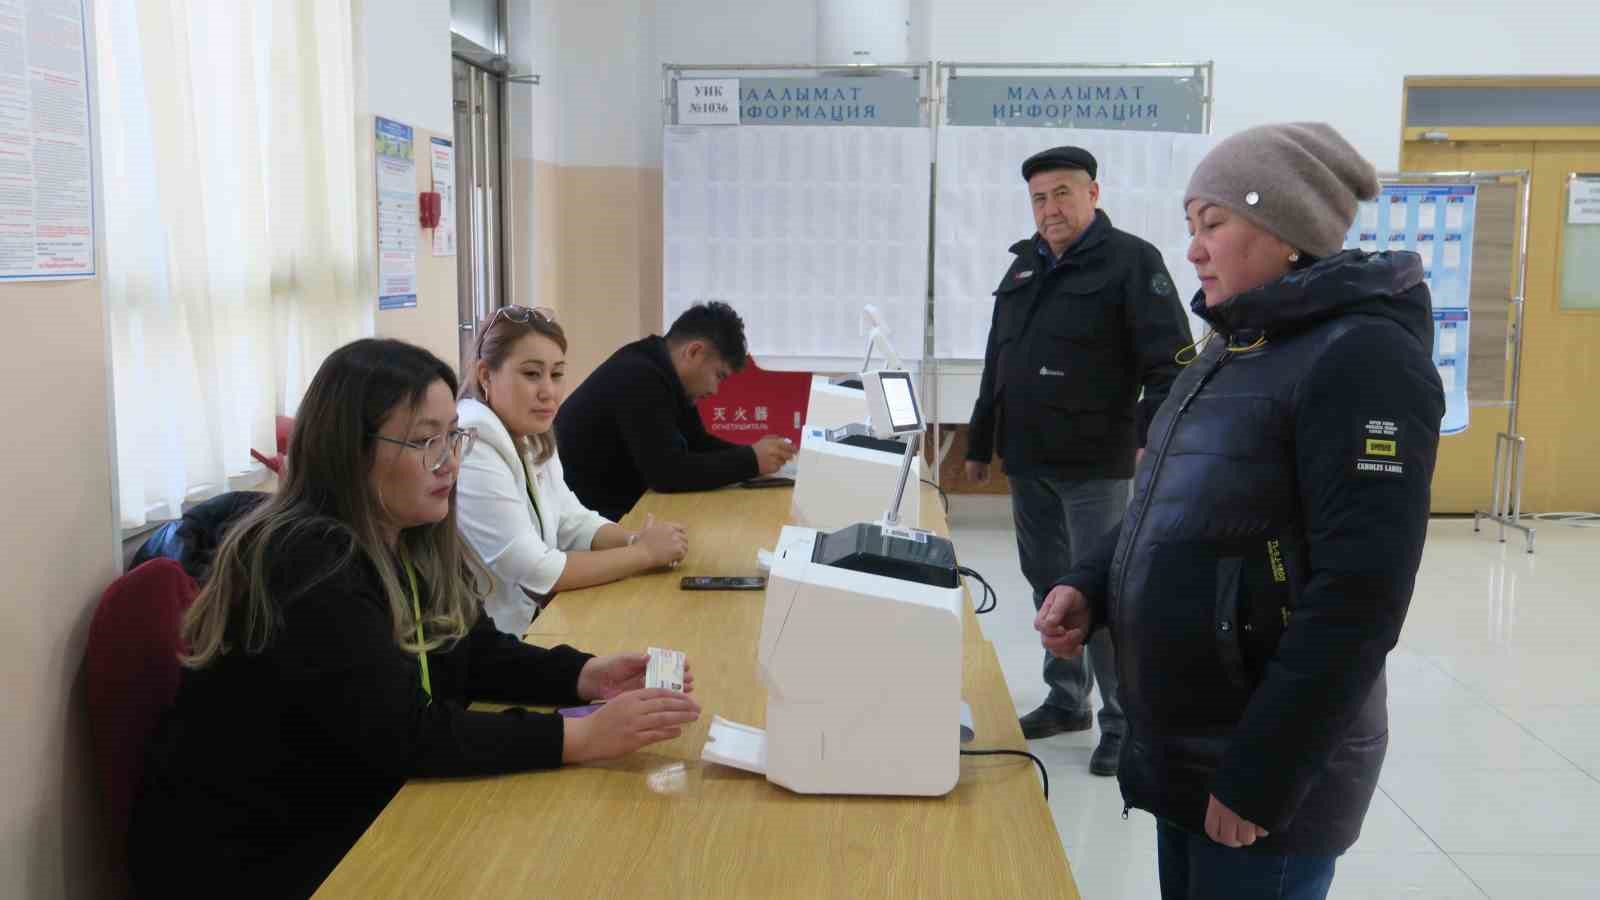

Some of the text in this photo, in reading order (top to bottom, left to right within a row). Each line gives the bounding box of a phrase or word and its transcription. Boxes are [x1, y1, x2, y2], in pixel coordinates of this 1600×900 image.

[694, 86, 723, 97] УИК
[739, 87, 864, 101] ААЛЫМАТ
[1007, 85, 1145, 100] МААЛЫМАТ
[688, 103, 728, 113] №1036
[739, 104, 876, 121] ФОРМАЦИЯ
[992, 103, 1159, 120] ИНФОРМАЦИЯ
